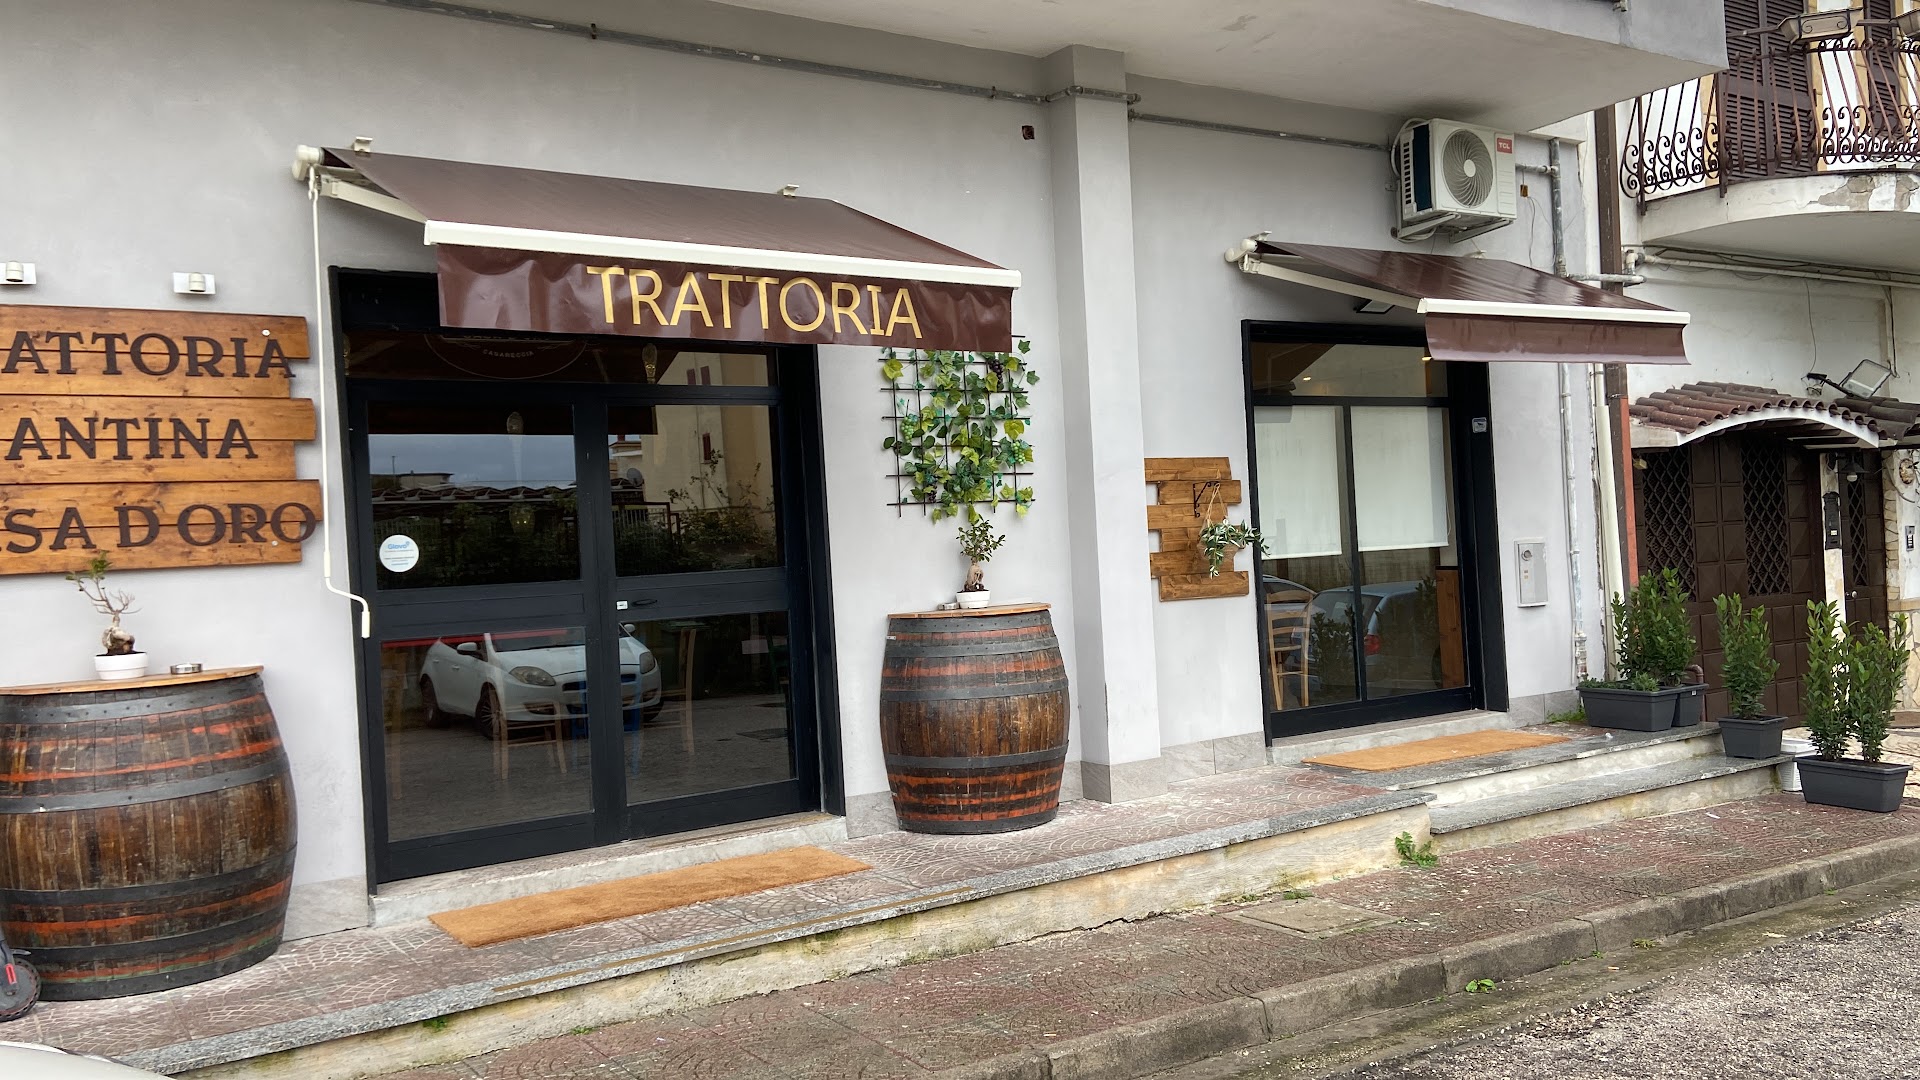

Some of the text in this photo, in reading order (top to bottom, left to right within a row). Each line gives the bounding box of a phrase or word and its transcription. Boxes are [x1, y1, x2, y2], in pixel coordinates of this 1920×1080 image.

[1498, 141, 1511, 150] TCL
[586, 265, 923, 339] TRATTORIA
[1, 331, 296, 378] ATTORIA
[4, 417, 258, 460] ANTINA
[0, 508, 97, 554] SA
